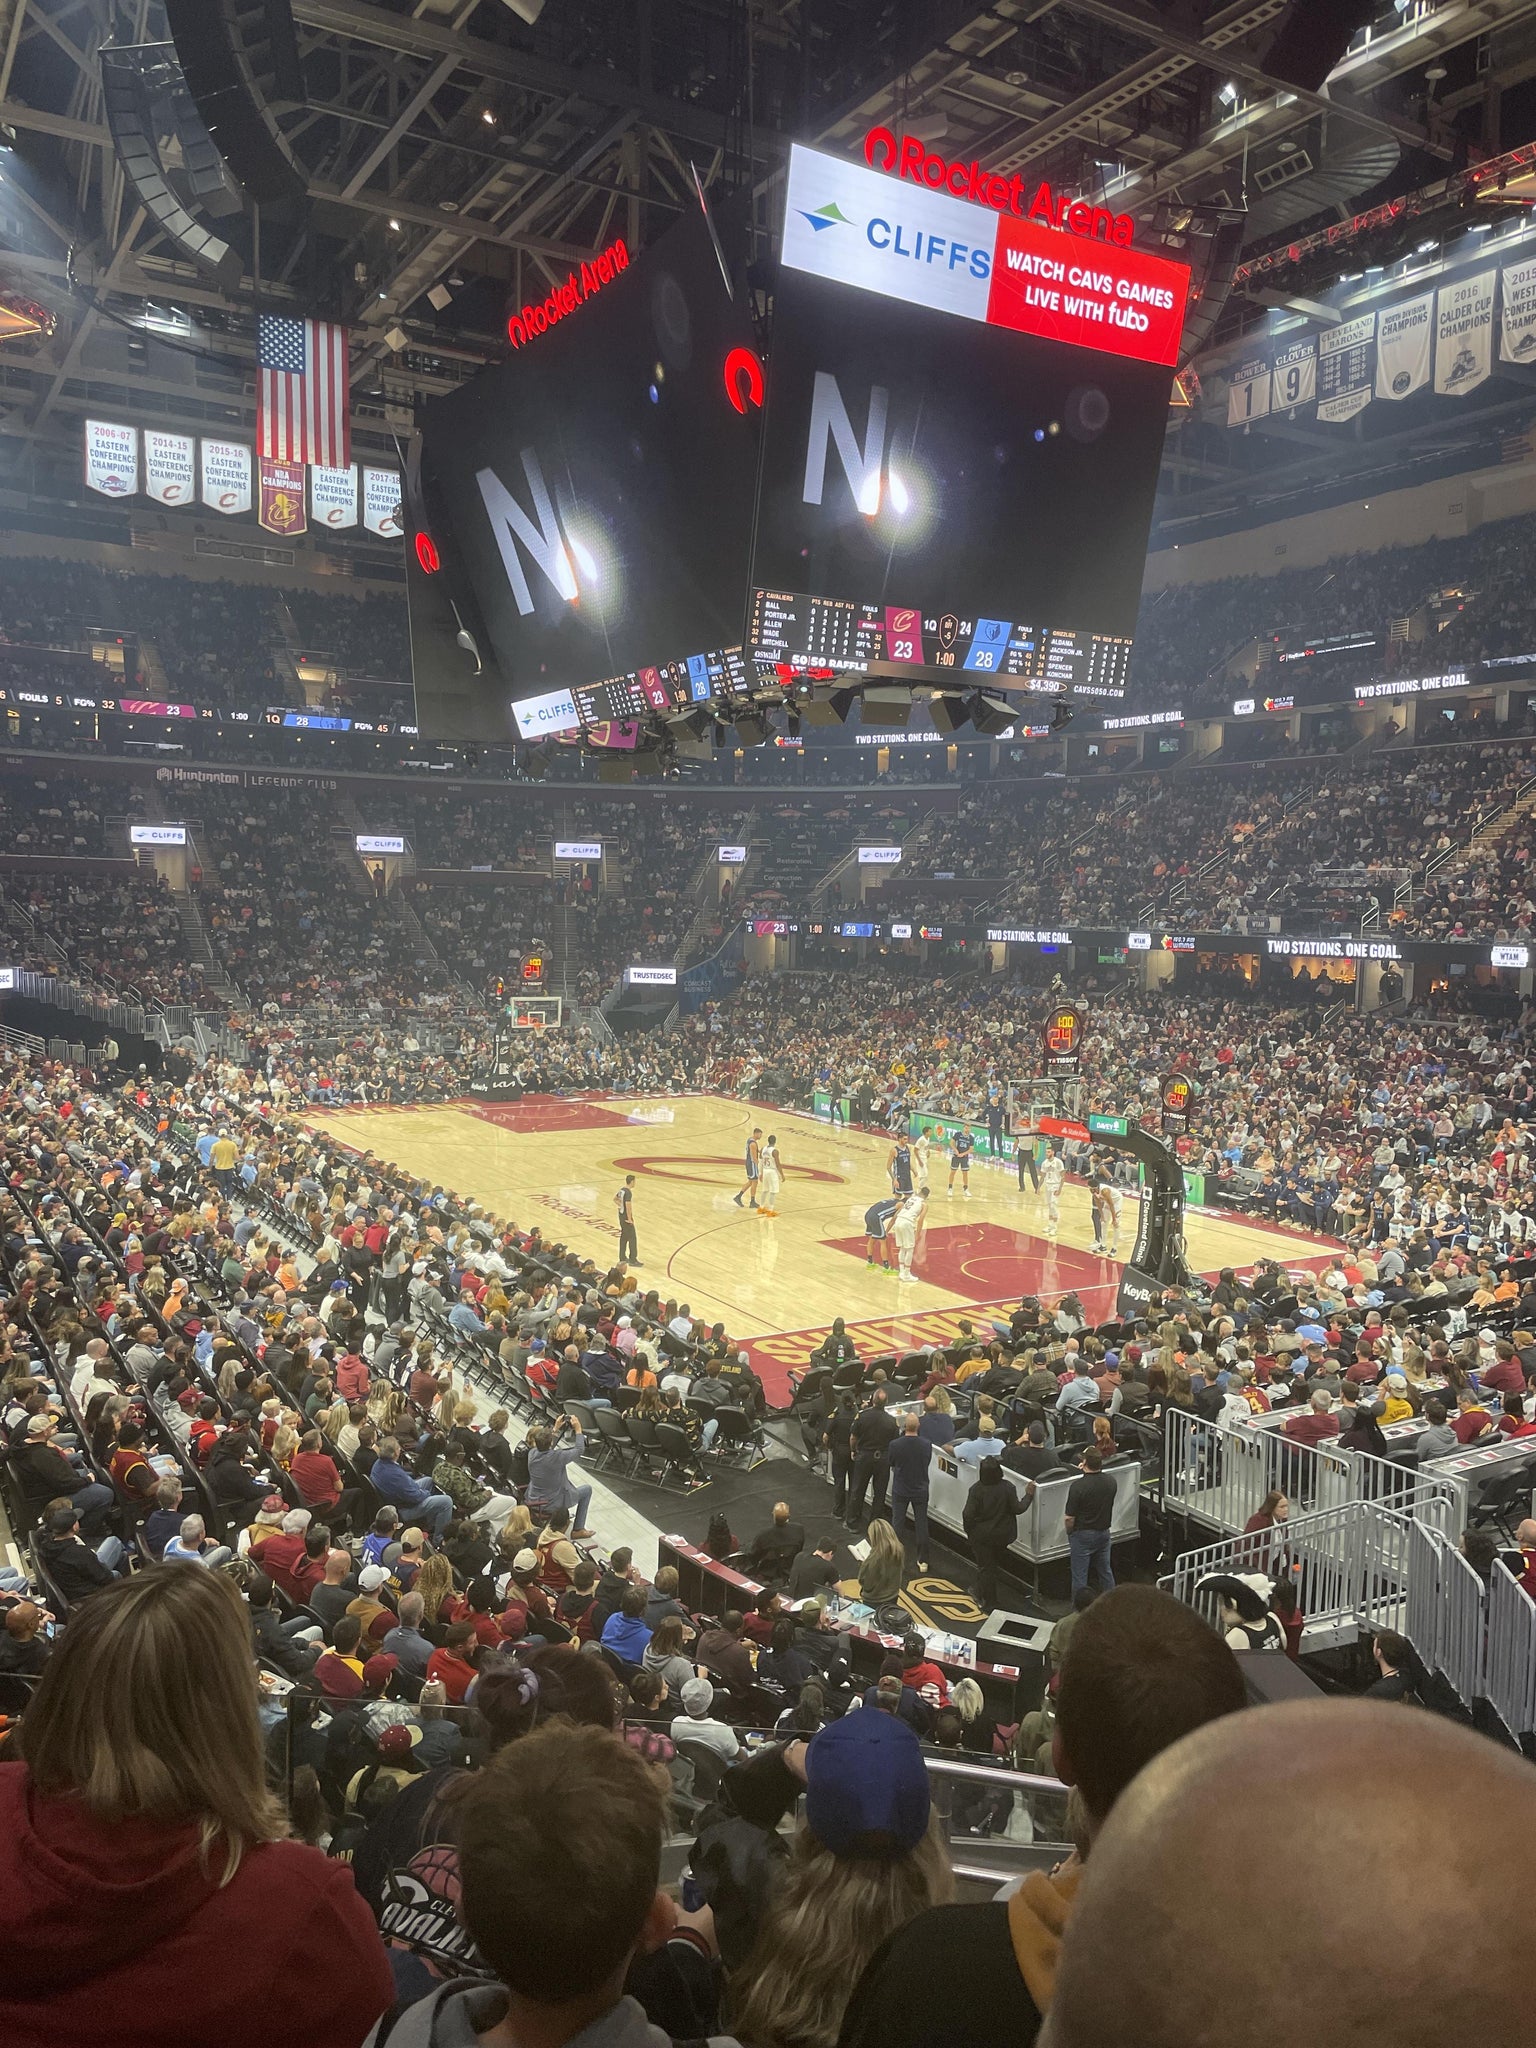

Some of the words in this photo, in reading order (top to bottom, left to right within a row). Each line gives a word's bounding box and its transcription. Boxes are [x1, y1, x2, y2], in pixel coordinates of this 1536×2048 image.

[900, 135, 1024, 214] Rocket
[1029, 182, 1134, 246] Arena
[866, 217, 990, 280] CLIFFS
[1007, 248, 1065, 282] WATCH
[1068, 265, 1113, 294] CAVS
[1116, 278, 1173, 309] GAMES
[1512, 268, 1536, 285] 2015
[522, 272, 582, 341] Rocket
[580, 239, 629, 300] Arena
[1454, 285, 1478, 303] 2016
[1512, 287, 1536, 302] WEST
[1026, 285, 1059, 312] LIVE
[1064, 294, 1103, 321] WITH
[1108, 302, 1148, 332] fubo
[1440, 303, 1472, 324] CALDER
[1475, 297, 1491, 311] CUP
[1504, 300, 1536, 318] CONFER
[1321, 317, 1373, 343] CLEVELAND
[1382, 312, 1427, 336] CHAMPIONS
[1440, 312, 1490, 339] CHAMPIONS
[1506, 315, 1536, 332] CHAMP
[1329, 330, 1364, 348] BARONS
[1275, 345, 1314, 366] GLOVER
[1234, 363, 1266, 381] BOWER
[1287, 367, 1300, 402] 9
[1244, 383, 1252, 416] 1
[94, 427, 131, 440] 2006-07
[96, 439, 129, 452] EASTERN
[153, 437, 187, 450] 2014-15
[803, 370, 888, 516] N
[90, 449, 136, 464] CONFERENCE
[154, 449, 186, 461] EASTERN
[209, 445, 244, 458] 2015-16
[92, 459, 135, 473] CHAMPIONS
[149, 458, 193, 473] CONFERENCE
[211, 457, 242, 469] EASTERN
[151, 469, 191, 482] CHAMPIONS
[205, 467, 248, 481] CONFERENCE
[275, 469, 289, 479] NBA
[320, 474, 349, 486] EASTERN
[207, 477, 247, 490] CHAMPIONS
[262, 476, 302, 491] CHAMPIONS
[314, 483, 355, 497] CONFERENCE
[371, 484, 399, 495] EASTERN
[316, 493, 353, 506] CHAMPIONS
[366, 493, 402, 504] CONFERENC
[368, 503, 393, 514] CHAMPI
[766, 592, 794, 602] CAVALIERS
[765, 601, 780, 610] BALL
[862, 604, 878, 613] FOULS
[764, 610, 787, 620] PORTER
[763, 620, 782, 629] ALLEN
[924, 620, 937, 631] 1Q
[959, 621, 972, 635] 24
[763, 629, 779, 637] WADE
[762, 638, 789, 648] MITCHELL
[893, 640, 913, 659] 23
[1050, 639, 1074, 647] ALDAMA
[754, 648, 781, 660] oswald
[935, 651, 955, 666] 1:00
[1050, 647, 1075, 656] JACKSON
[828, 660, 868, 671] RAFFLE
[975, 650, 993, 668] 28
[1047, 662, 1073, 671] SPENCER
[1046, 671, 1073, 680] KONCHAR
[695, 681, 707, 696] 28
[1029, 678, 1059, 692] $4,390
[1074, 685, 1125, 698] CAVS5050.COM
[1354, 686, 1375, 699] TWO
[1375, 680, 1421, 696] STATIONS.
[1421, 677, 1441, 691] ONE
[1442, 673, 1470, 687] GOAL.
[652, 690, 664, 705] 23
[19, 693, 48, 703] FOULS
[55, 696, 63, 705] 5
[102, 700, 115, 709] 32
[166, 705, 180, 716] 23
[231, 711, 249, 721] 1:00
[265, 714, 281, 724] 1Q
[296, 716, 309, 726] 28
[377, 724, 389, 733] 45
[400, 725, 418, 734] FOU
[538, 702, 575, 721] CLIFFS
[1103, 718, 1119, 729] TWO
[1119, 715, 1152, 728] STATIONS.
[1152, 713, 1165, 724] ONE
[1165, 710, 1185, 722] GOAL.
[855, 735, 871, 744] TWO
[872, 734, 907, 743] STATIONS.
[908, 733, 922, 742] ONE
[151, 831, 184, 840] CLIFFS
[374, 840, 402, 848] CLIFFS
[874, 851, 902, 859] CLIFFS
[773, 923, 785, 932] 23
[808, 924, 823, 934] 1:00
[846, 925, 857, 934] 28
[987, 929, 1002, 941] TWO
[1002, 930, 1036, 942] STATIONS.
[1037, 931, 1050, 943] ONE
[1051, 932, 1072, 944] GOAL.
[1133, 937, 1146, 945] WTAM
[1267, 940, 1290, 954] TWO
[1291, 941, 1344, 956] STATIONS.
[1346, 942, 1368, 957] ONE
[1369, 944, 1402, 959] GOAL.
[1500, 952, 1519, 961] WTAM
[524, 965, 540, 978] 24
[633, 972, 673, 980] TRUSTEDSEC
[1058, 1016, 1074, 1028] 1:00
[1048, 1028, 1072, 1049] 24
[1056, 1056, 1078, 1064] TISSOT
[1174, 1083, 1188, 1095] 1:00
[1169, 1093, 1184, 1106] 24
[1141, 1201, 1150, 1240] Cleveland
[1136, 1240, 1147, 1263] Clinic
[1123, 1282, 1151, 1303] KeyB
